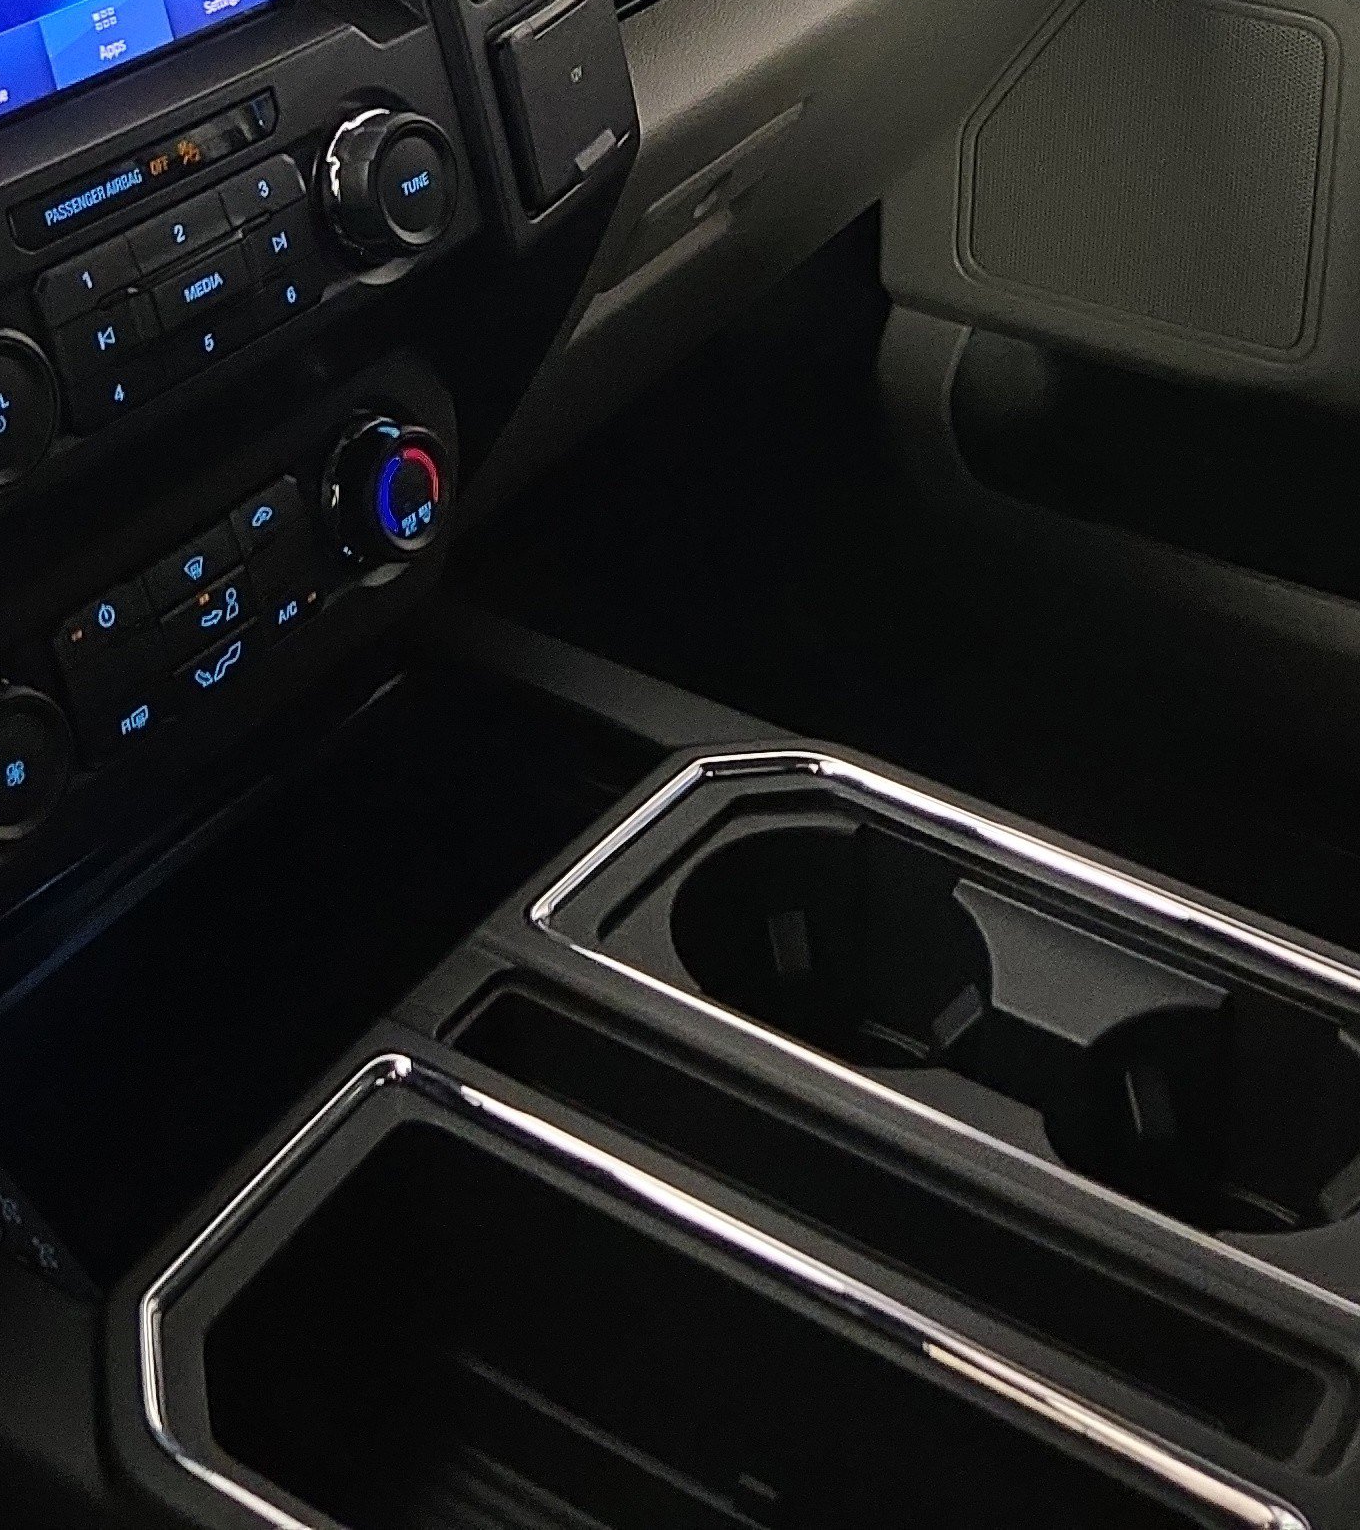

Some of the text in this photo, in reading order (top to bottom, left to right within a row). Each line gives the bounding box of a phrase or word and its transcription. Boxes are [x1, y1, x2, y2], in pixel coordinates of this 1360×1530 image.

[99, 38, 127, 62] Apps
[258, 179, 270, 198] 3
[400, 172, 430, 197] TUNE
[45, 185, 106, 227] PASSENGER
[106, 168, 143, 199] AIRBAG
[173, 224, 186, 243] 2
[81, 270, 93, 289] 1
[183, 272, 224, 303] MEDIA
[285, 285, 297, 304] 6
[203, 333, 215, 353] 5
[113, 383, 125, 402] 4
[278, 600, 298, 624] A/C
